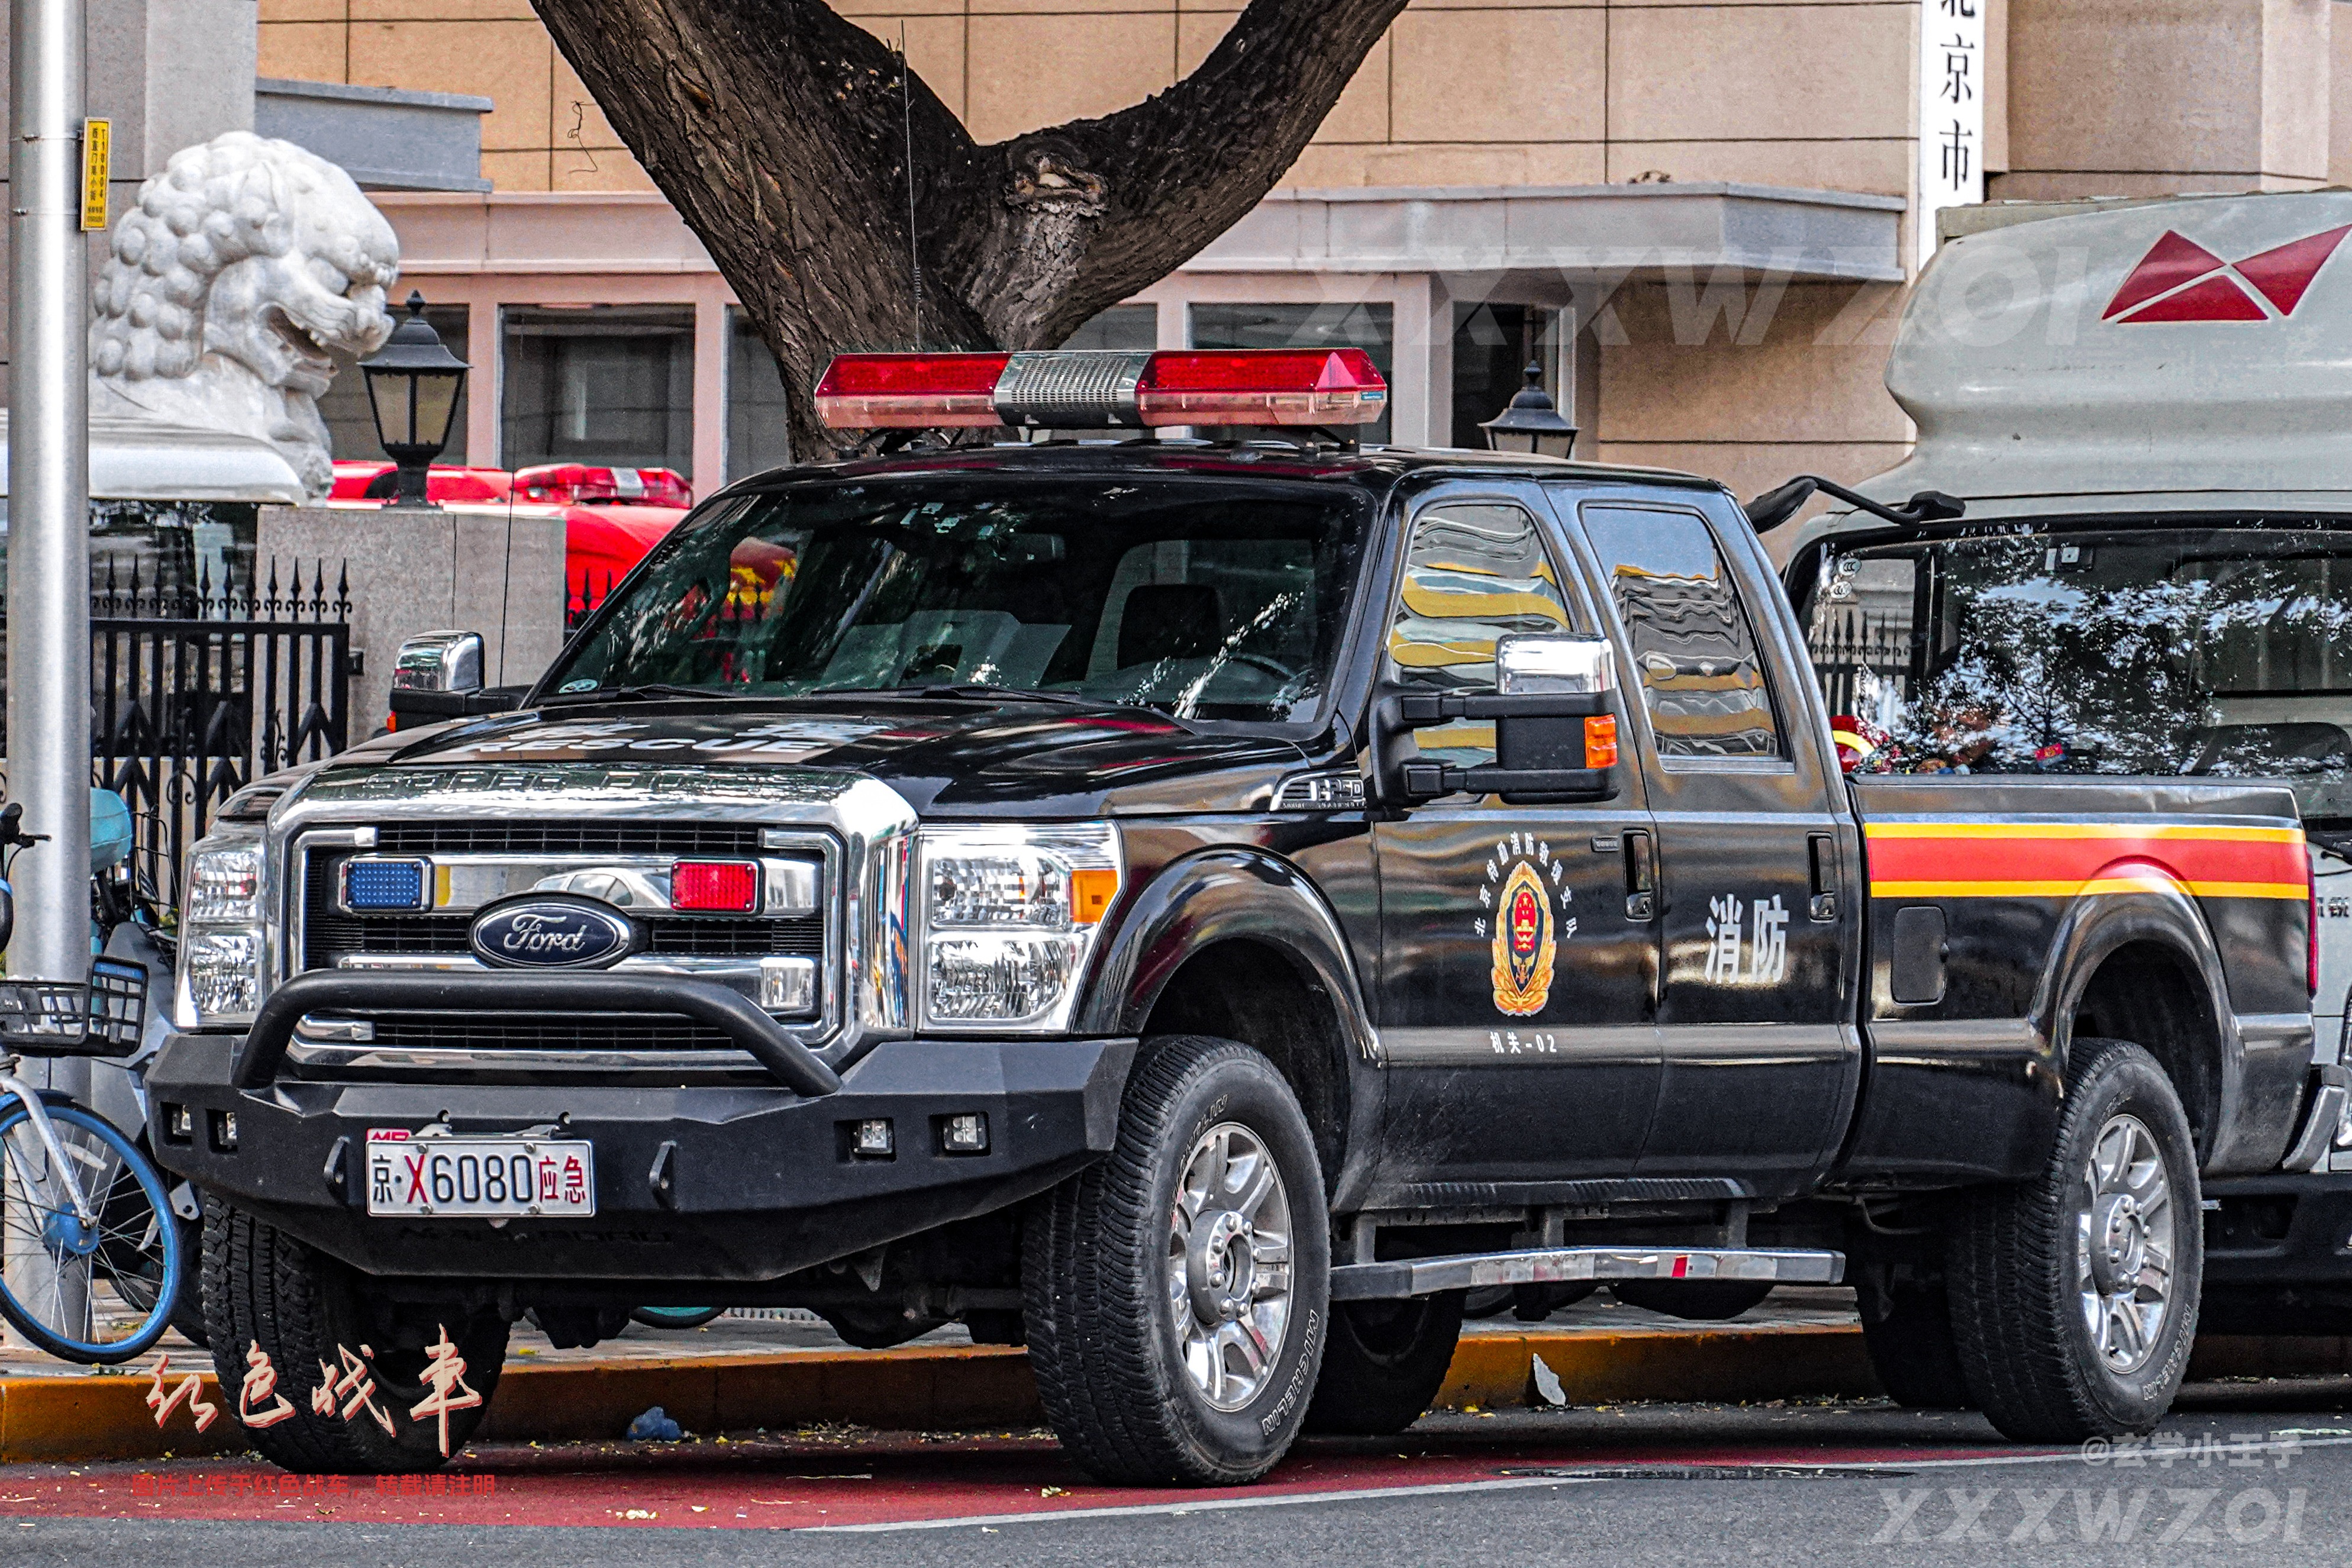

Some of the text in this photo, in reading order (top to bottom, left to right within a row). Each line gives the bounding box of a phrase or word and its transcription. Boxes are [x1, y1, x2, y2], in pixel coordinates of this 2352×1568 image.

[1938, 0, 1975, 191] 京市
[441, 737, 829, 753] RESCUE
[504, 913, 588, 953] Ford
[1704, 893, 1790, 984] 消防
[1261, 1309, 1319, 1436] MICHELIN
